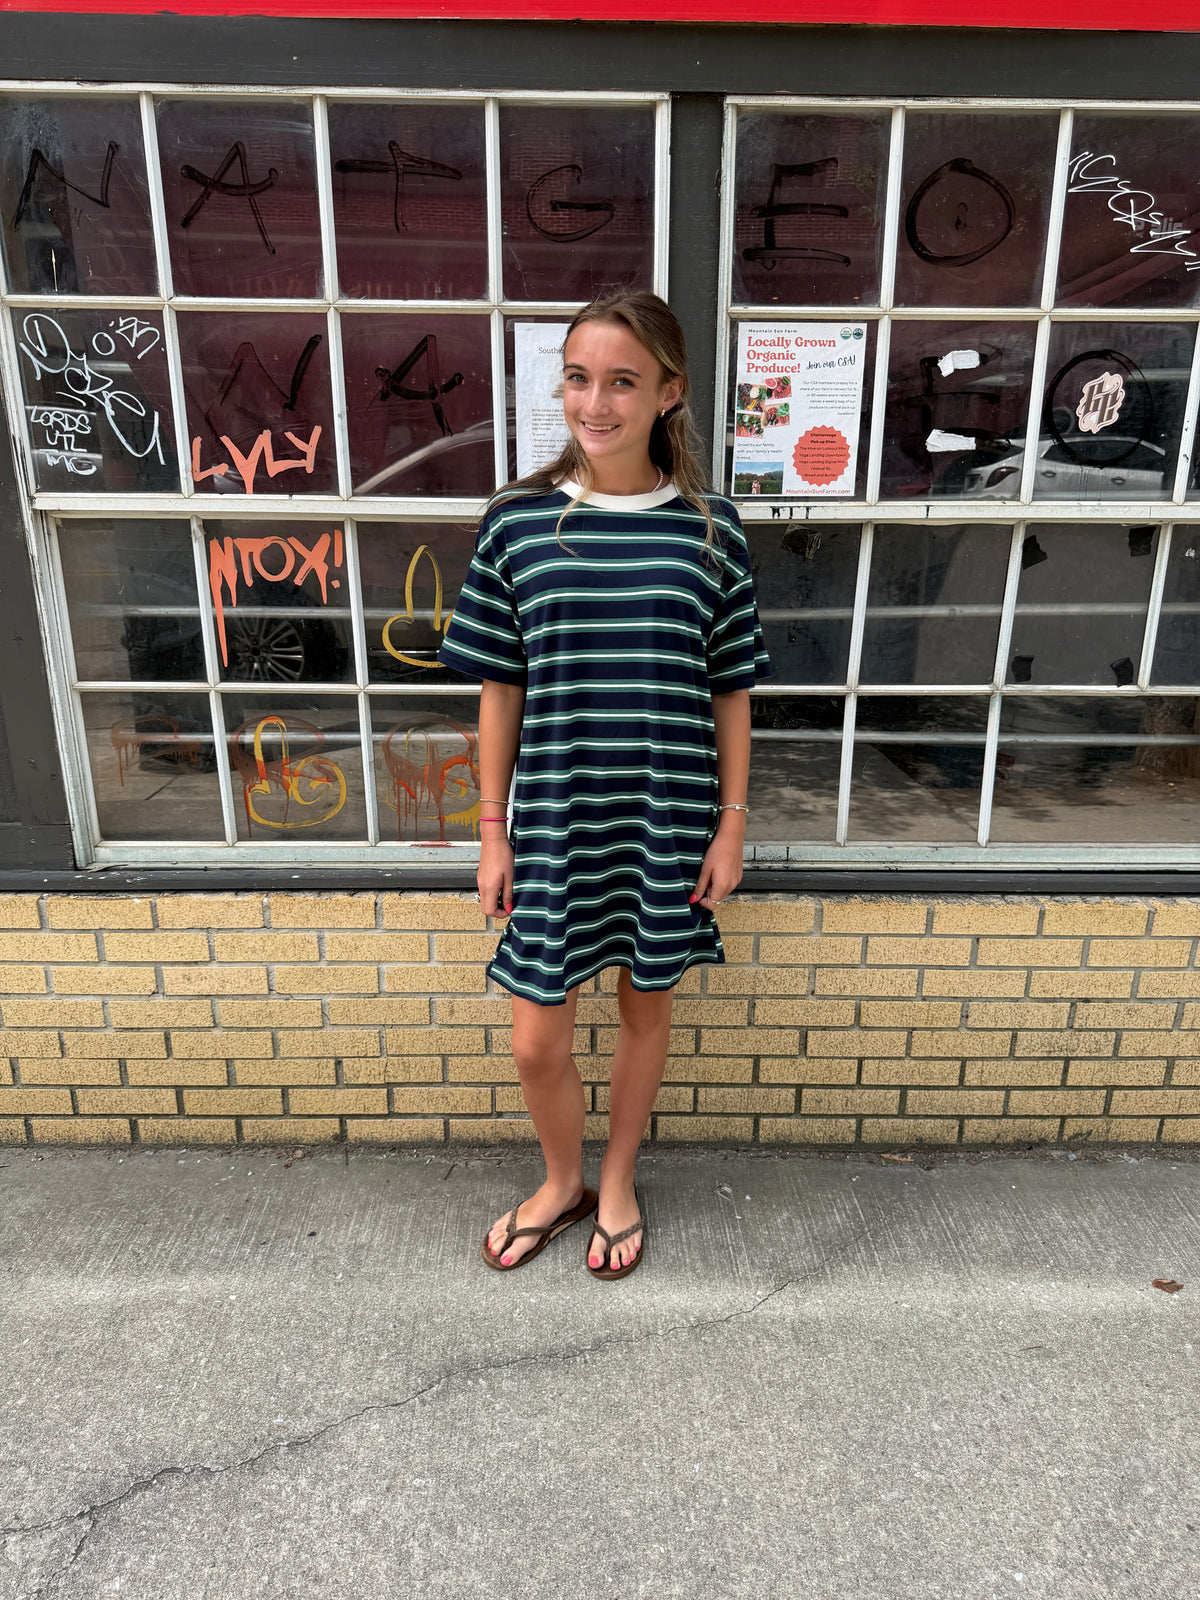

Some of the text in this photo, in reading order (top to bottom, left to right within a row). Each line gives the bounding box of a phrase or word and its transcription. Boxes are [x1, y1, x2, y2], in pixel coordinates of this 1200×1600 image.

[747, 336, 837, 349] Locally Grown
[746, 349, 796, 362] Organic
[746, 362, 801, 373] Produce!
[806, 361, 822, 370] Join
[837, 355, 856, 367] CSA!
